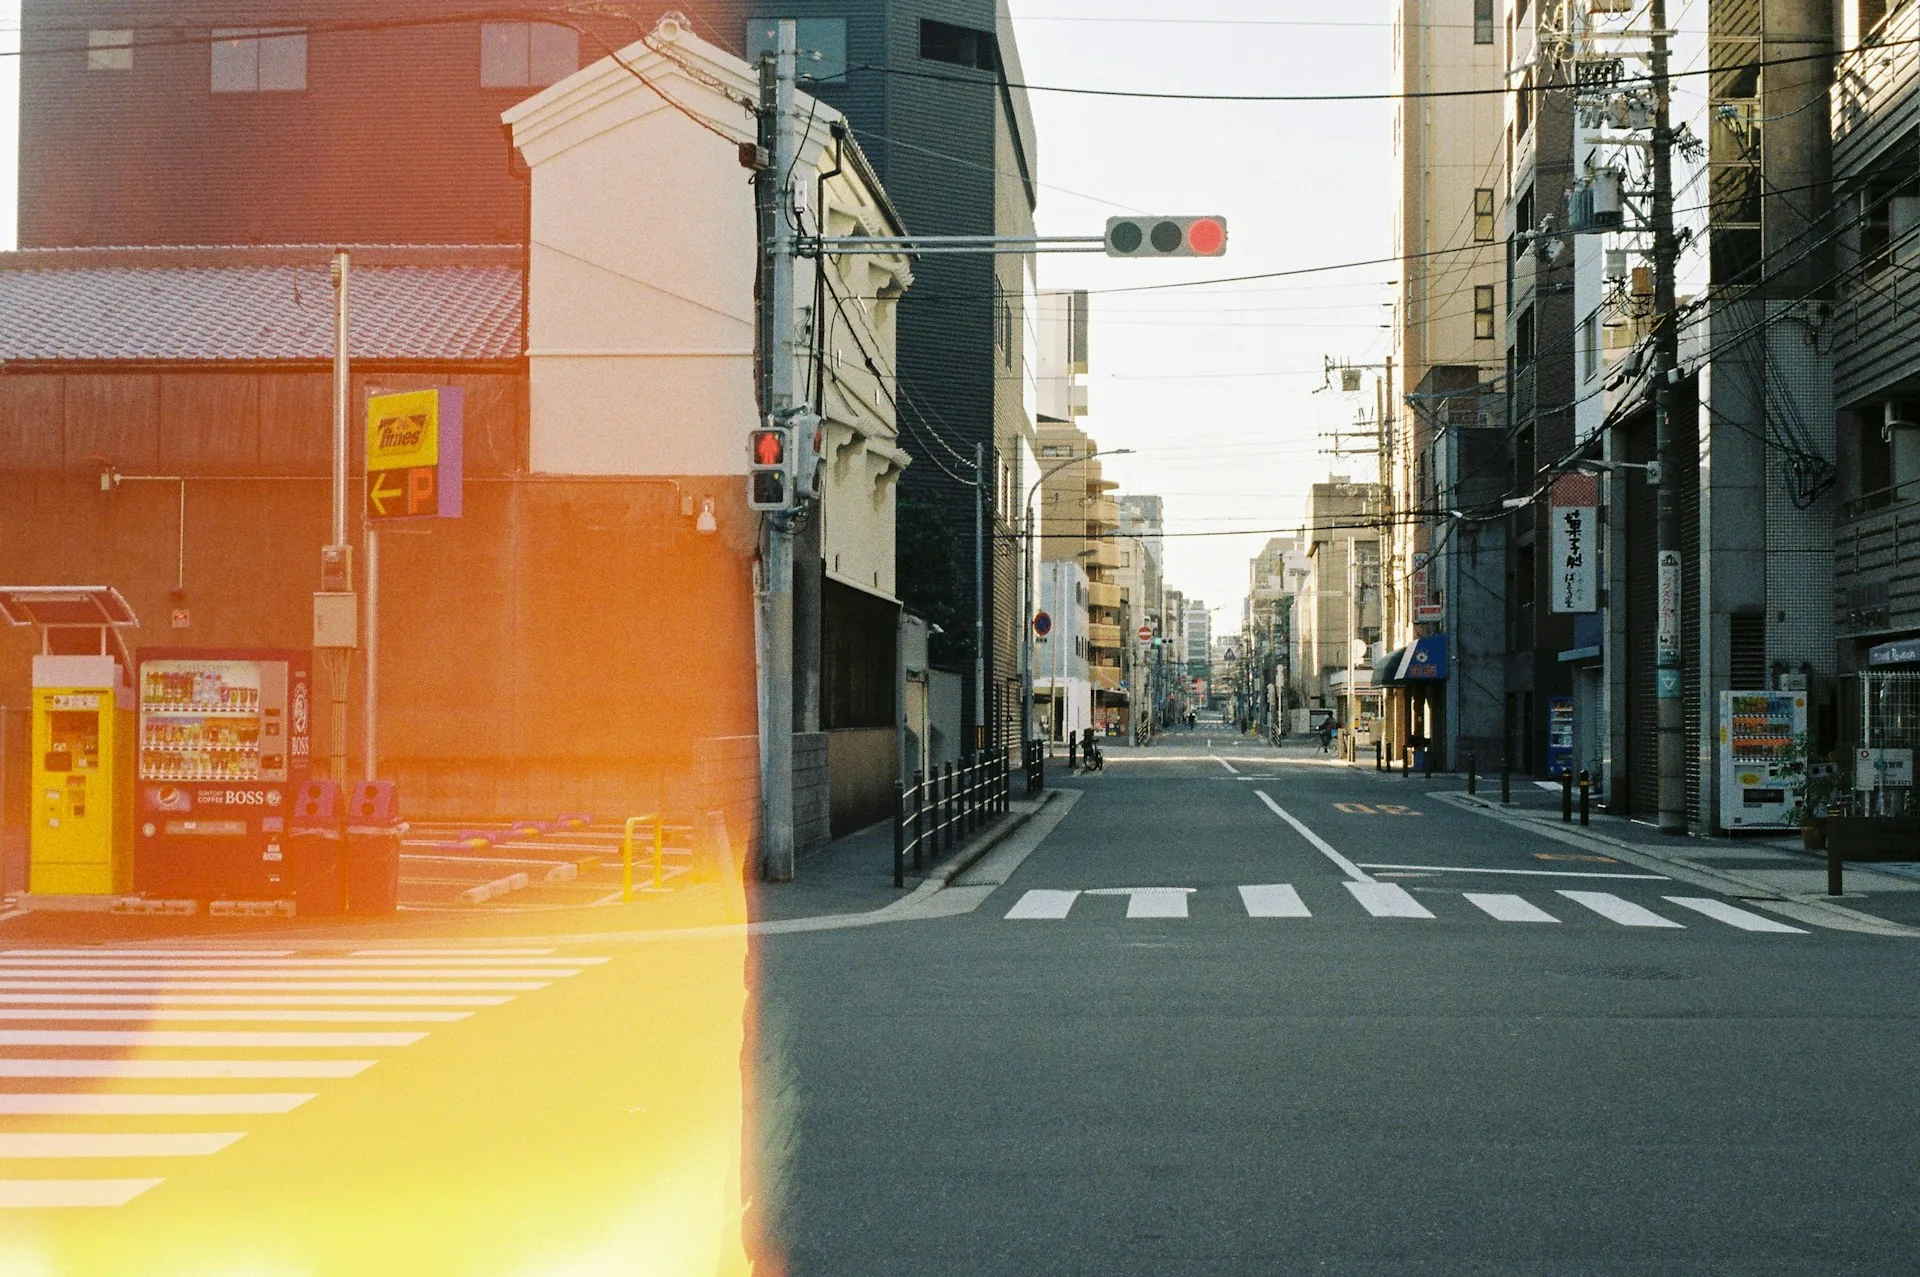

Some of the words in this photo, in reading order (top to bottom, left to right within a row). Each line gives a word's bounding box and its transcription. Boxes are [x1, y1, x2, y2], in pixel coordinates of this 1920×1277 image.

[379, 424, 421, 450] Times
[410, 468, 433, 515] P
[291, 736, 309, 756] BOSS
[197, 796, 224, 804] COFFEE
[225, 790, 264, 805] BOSS
